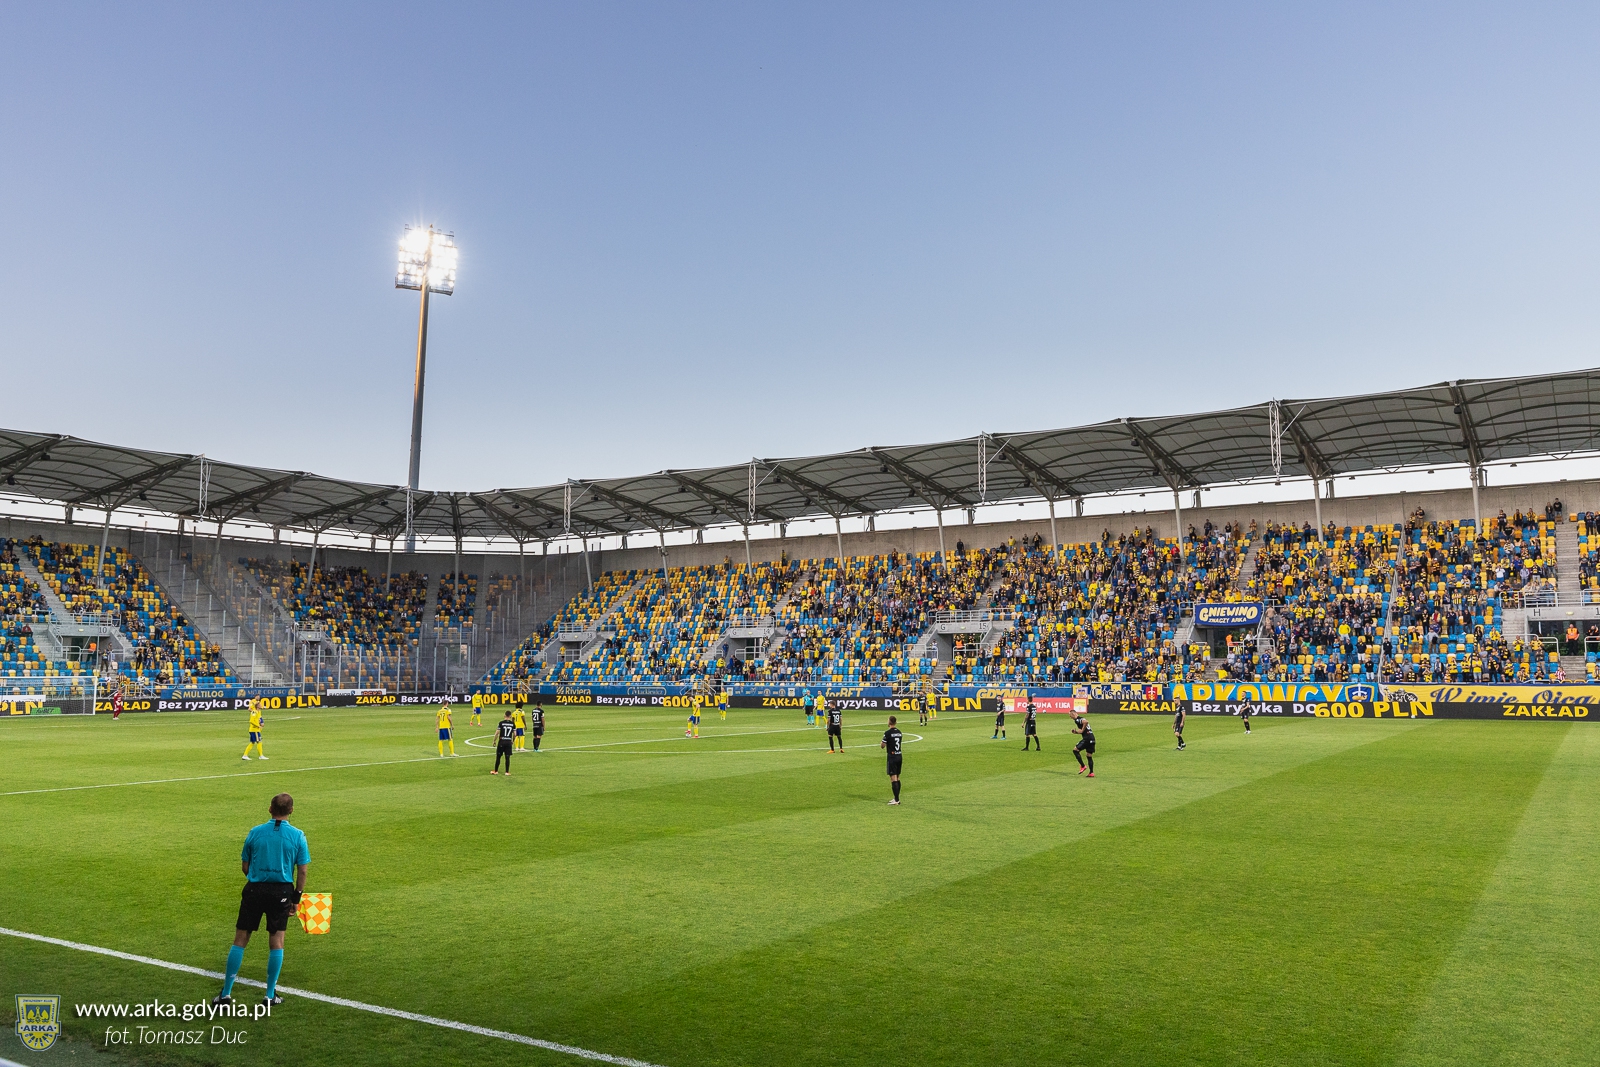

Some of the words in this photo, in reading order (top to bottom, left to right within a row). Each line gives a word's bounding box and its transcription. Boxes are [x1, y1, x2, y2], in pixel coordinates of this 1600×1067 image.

[1199, 606, 1258, 622] GNIEWINO
[183, 690, 224, 698] MULTILOG
[976, 689, 1028, 698] GDYNIA
[1171, 683, 1345, 701] ARKOWCY
[1430, 687, 1462, 702] W
[159, 701, 182, 710] Bez
[185, 699, 228, 711] ryzyka
[287, 695, 321, 707] PLN
[356, 696, 396, 704] ZAKŁAD
[401, 695, 419, 703] Bez
[421, 695, 458, 705] ryzyka
[501, 693, 528, 704] PLN
[556, 695, 592, 703] ZAKŁAD
[596, 696, 612, 704] Bez
[615, 696, 646, 706] ryzyka
[663, 695, 690, 707] 600
[837, 698, 878, 709] ryzyka
[941, 697, 982, 710] PLN
[95, 701, 151, 712] ZAŁAD
[1192, 702, 1221, 712] Bez
[1225, 701, 1283, 715] ryyka
[1293, 703, 1316, 714] DO
[1315, 702, 1364, 718] 600
[1374, 701, 1434, 717] PLN
[1503, 705, 1589, 717] ZAKŁAD
[532, 712, 539, 721] 21
[503, 726, 512, 737] 17
[895, 737, 900, 750] 3
